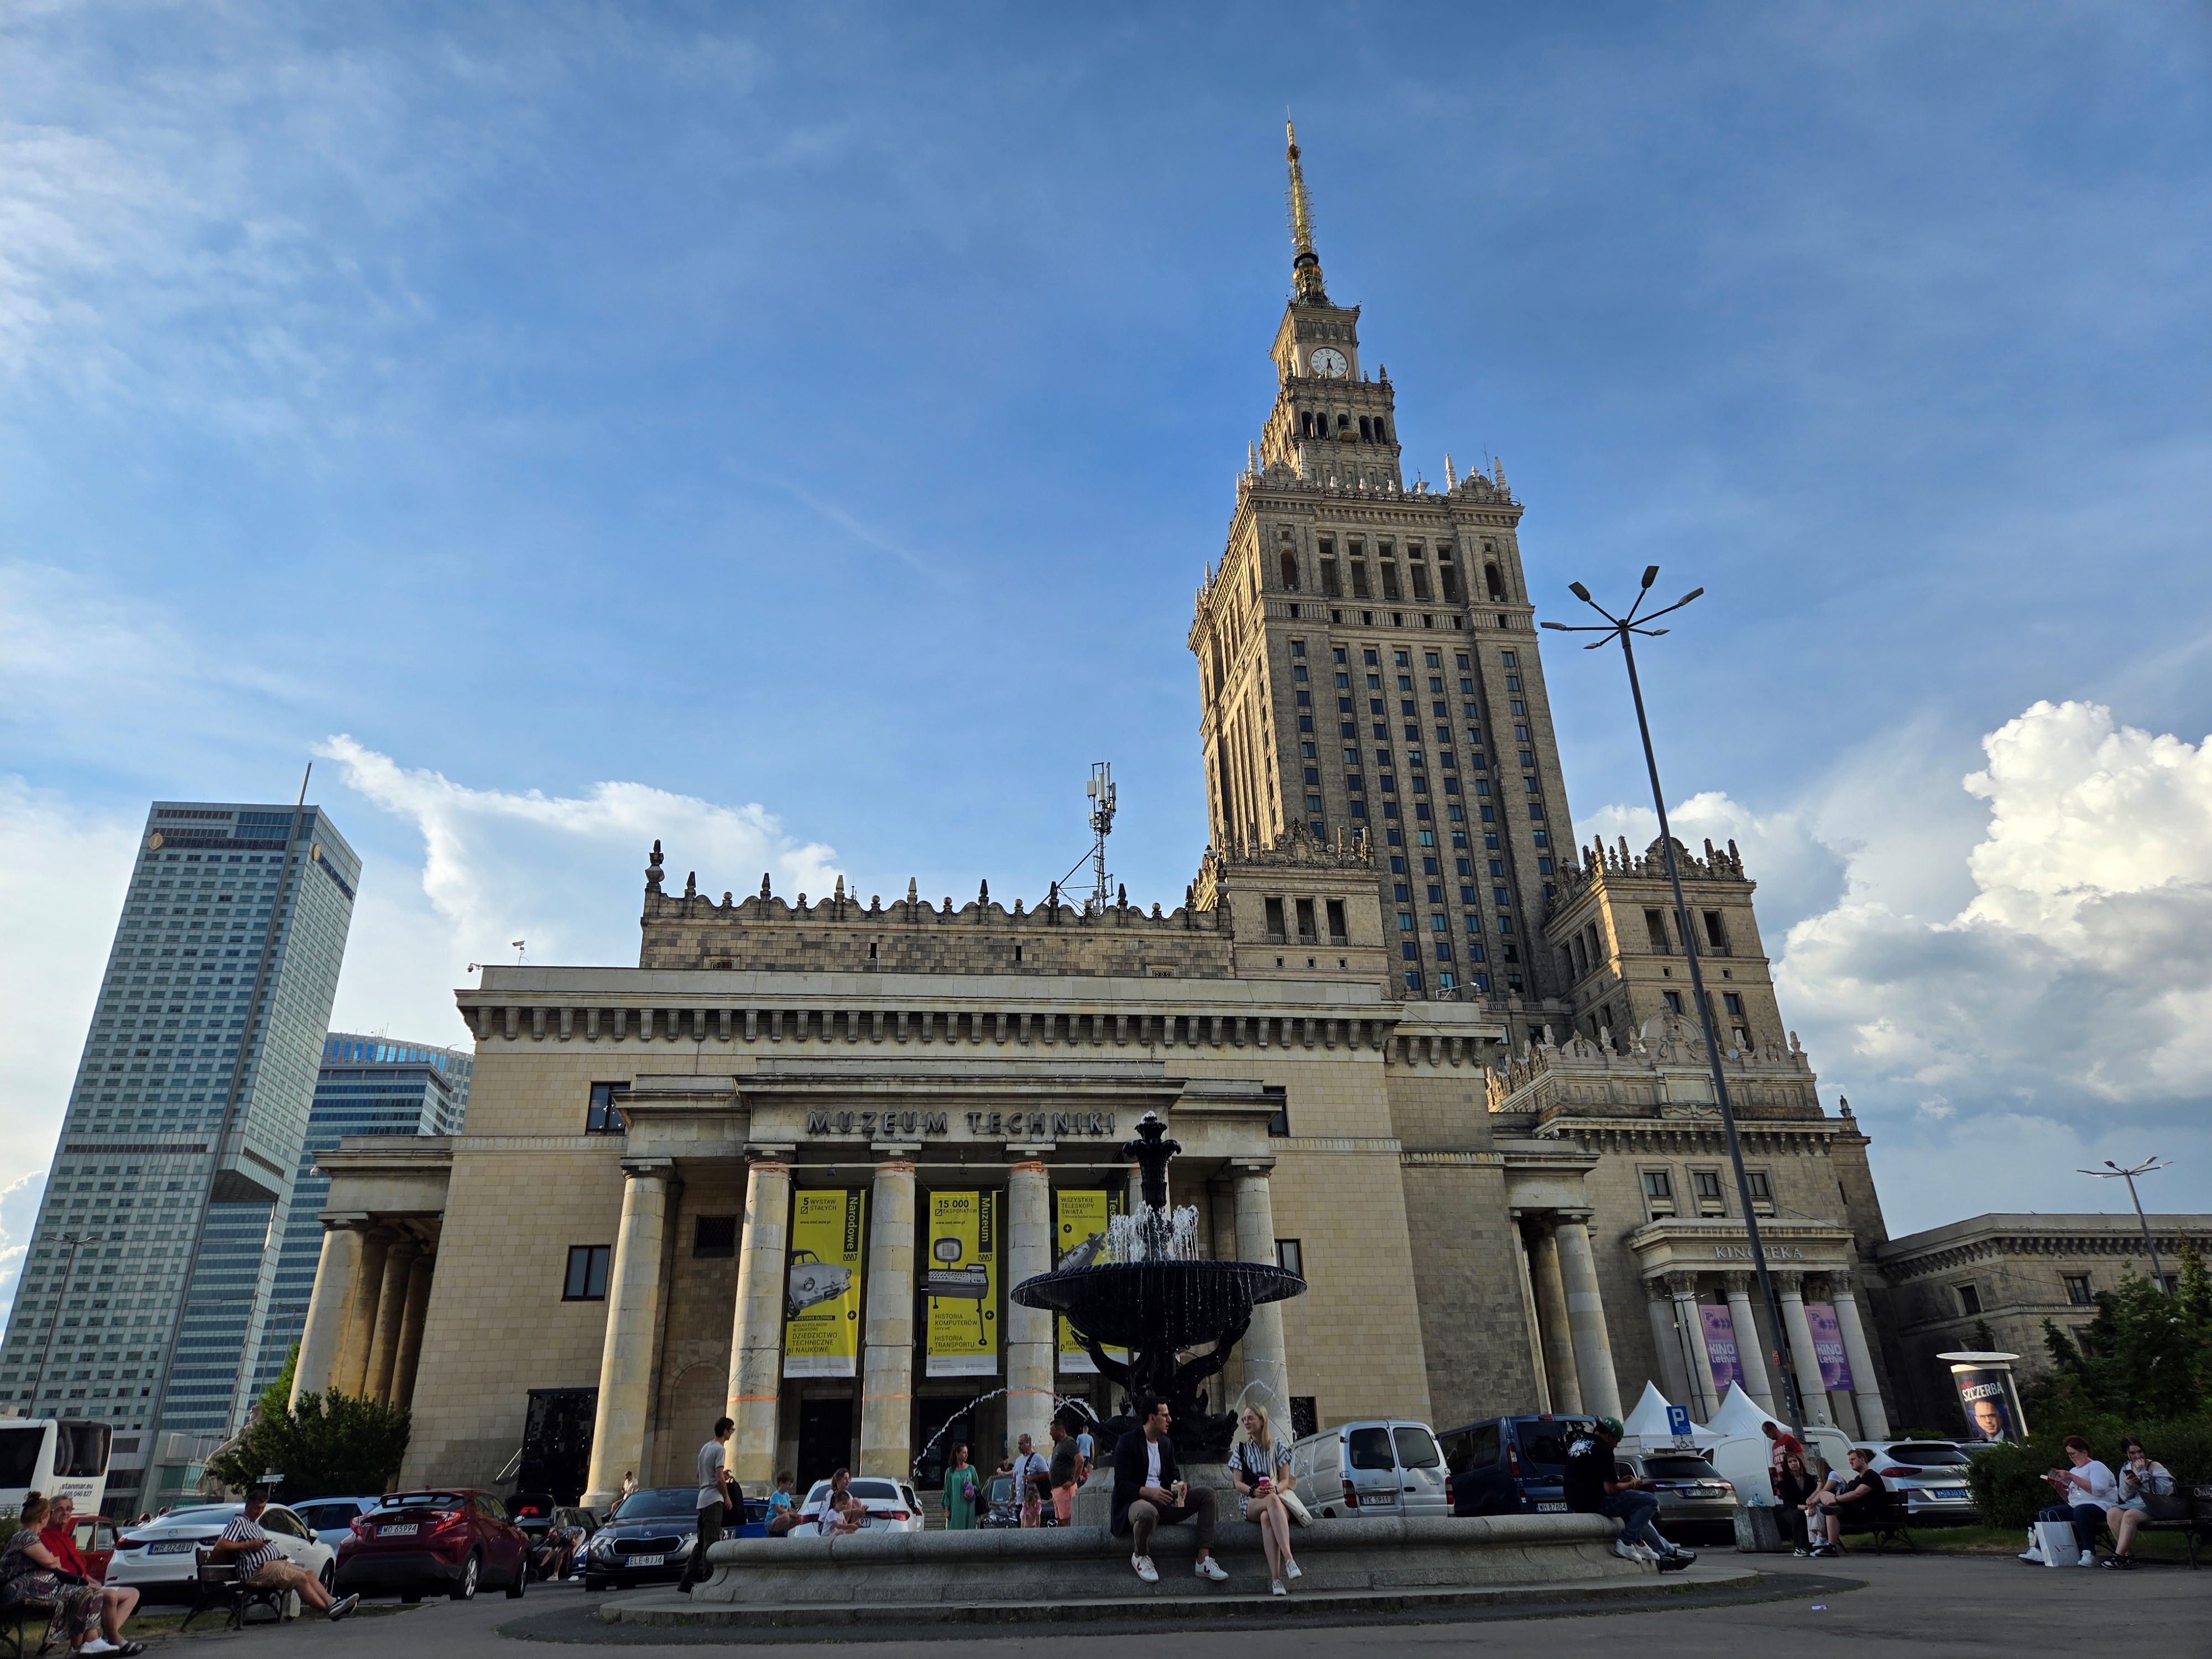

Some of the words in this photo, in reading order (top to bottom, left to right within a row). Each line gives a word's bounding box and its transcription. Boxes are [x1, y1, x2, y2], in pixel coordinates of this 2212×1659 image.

[807, 1111, 948, 1133] MUZEUM
[967, 1112, 1116, 1134] TECHNIKI
[952, 1199, 969, 1208] 000
[847, 1197, 858, 1249] Narodowe
[982, 1198, 990, 1241] Muzeum
[1709, 1343, 1735, 1355] KINO
[1817, 1344, 1842, 1355] KINO
[1711, 1355, 1737, 1363] Letnie
[1962, 1381, 2004, 1402] SZCZERBA
[1672, 1408, 1684, 1426] P
[394, 1524, 416, 1532] 65994
[154, 1544, 166, 1553] WR
[167, 1543, 191, 1552] 0248V
[630, 1557, 643, 1565] ELE
